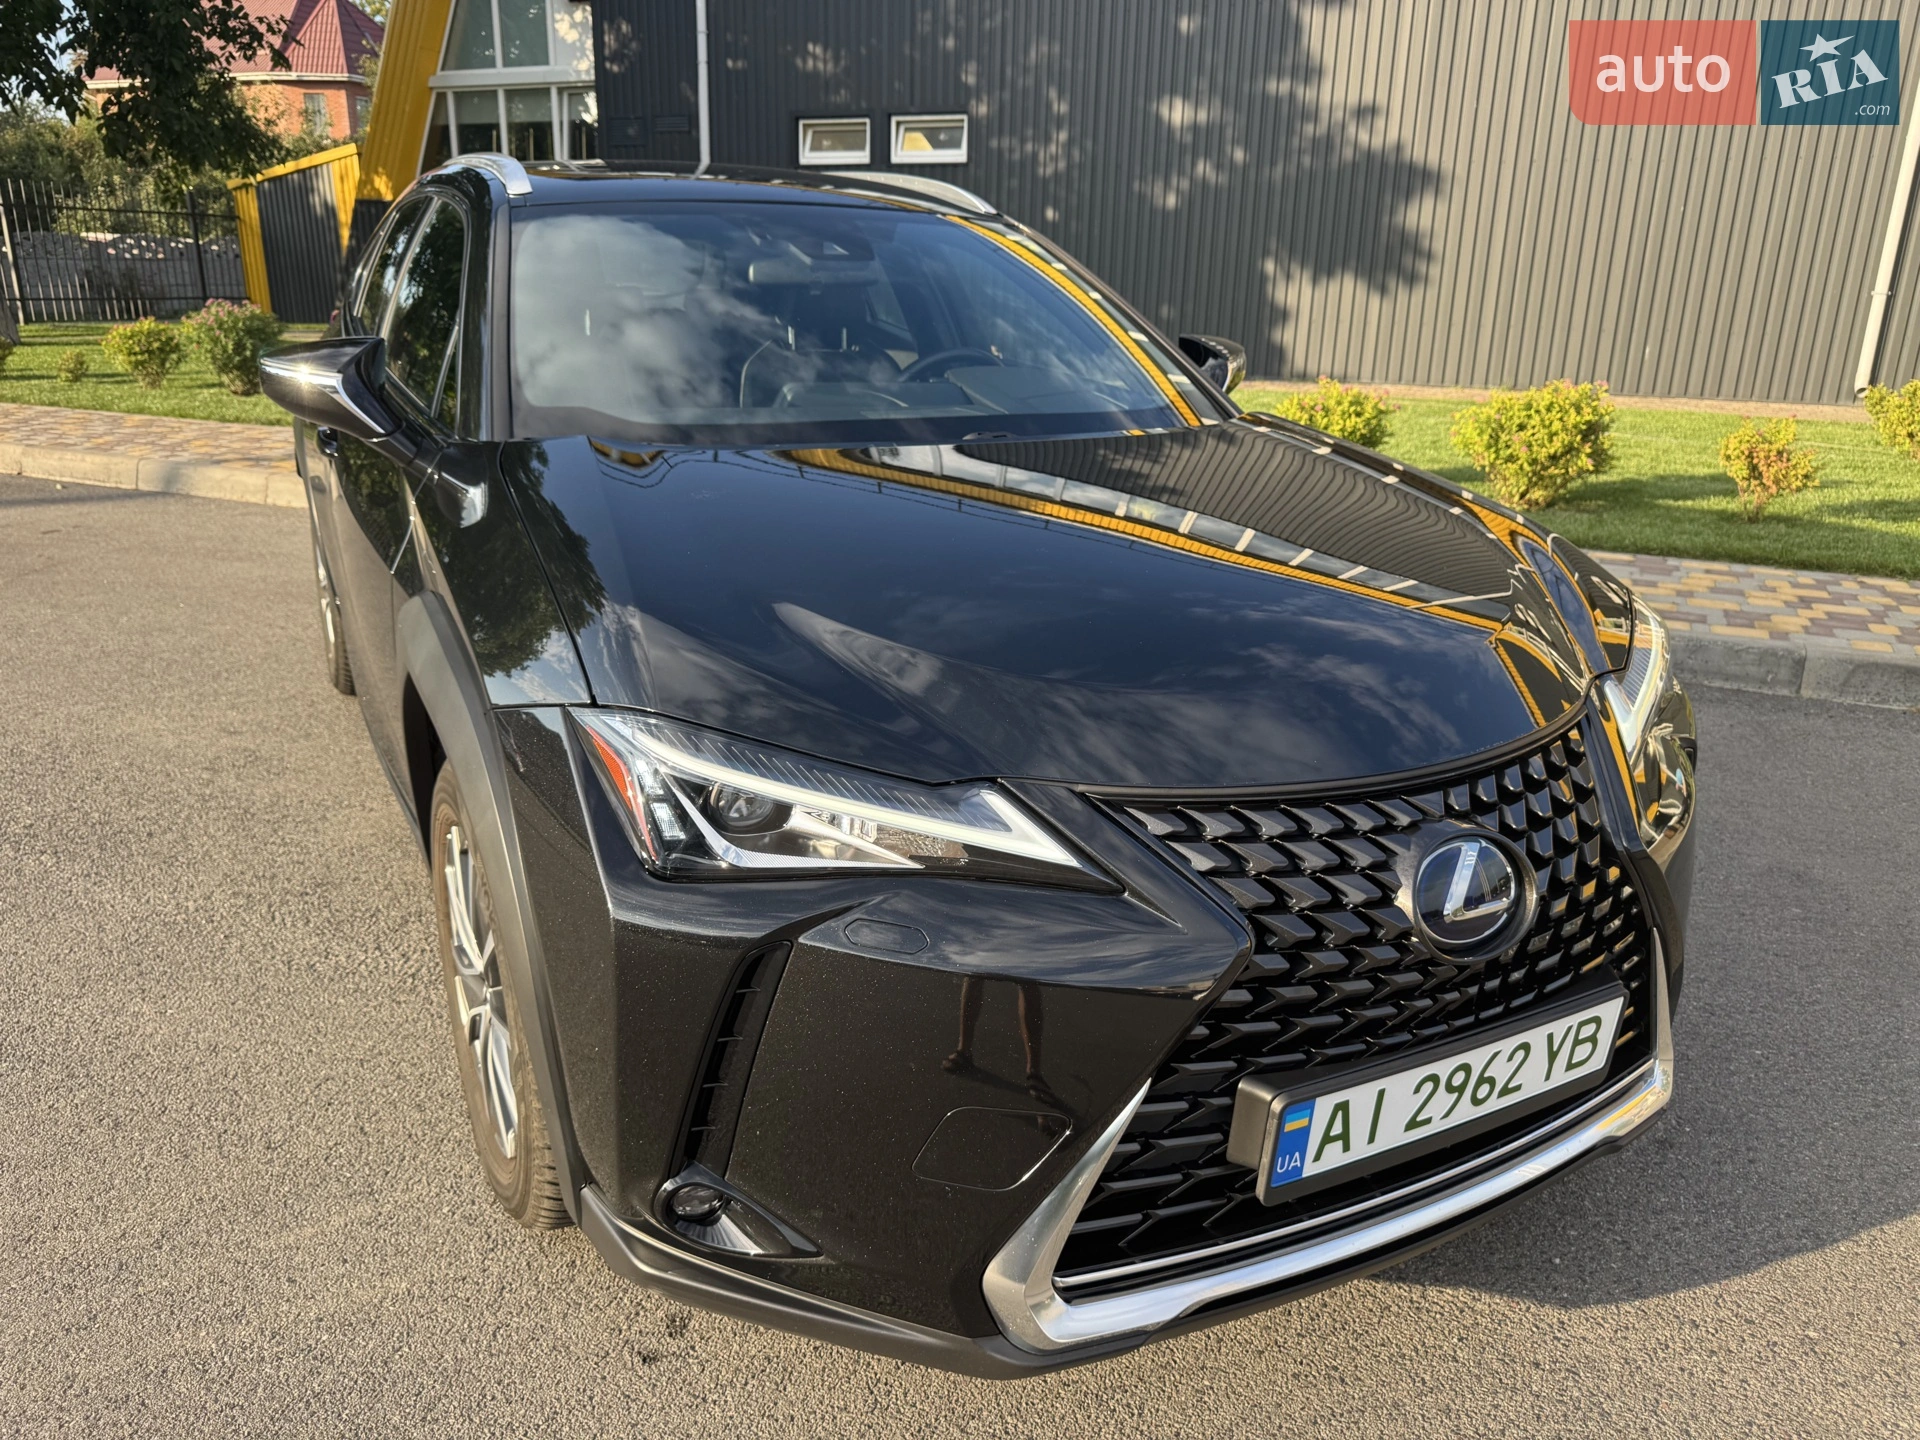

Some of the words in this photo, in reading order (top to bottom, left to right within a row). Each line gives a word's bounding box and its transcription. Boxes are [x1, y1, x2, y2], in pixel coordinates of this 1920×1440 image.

[1312, 1087, 1385, 1163] AI
[1403, 1041, 1531, 1133] 2962
[1543, 1015, 1602, 1083] YB
[1275, 1151, 1301, 1173] UA
